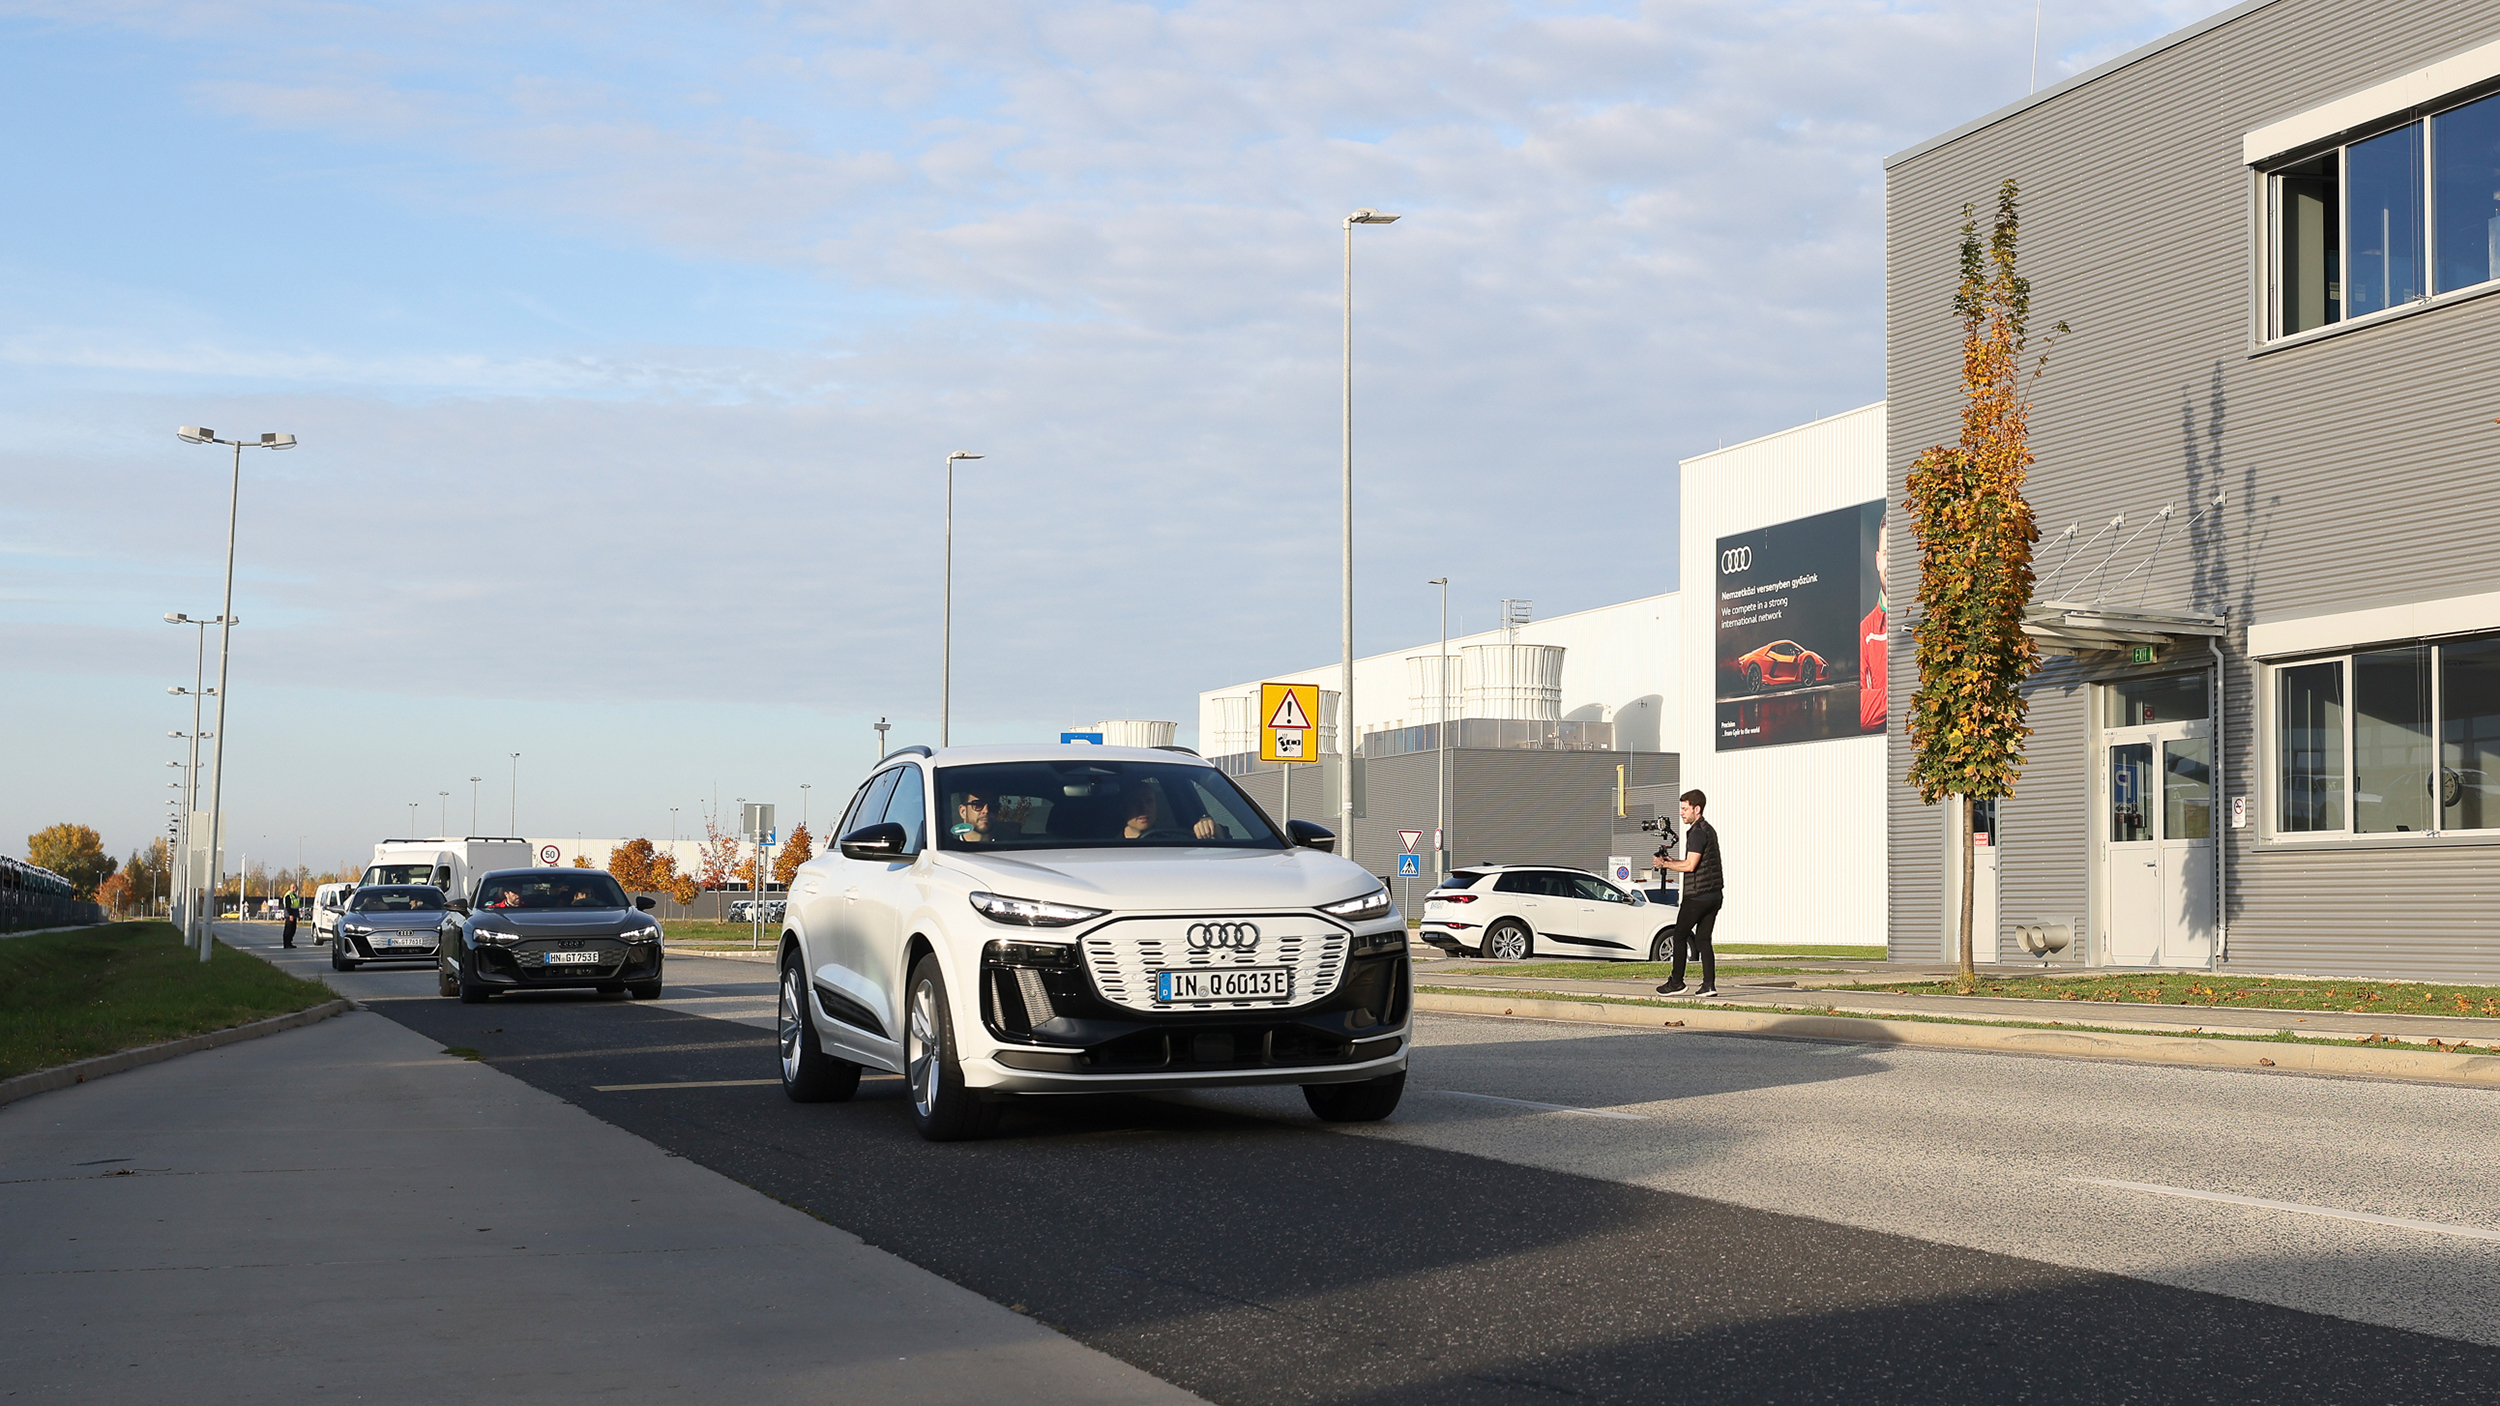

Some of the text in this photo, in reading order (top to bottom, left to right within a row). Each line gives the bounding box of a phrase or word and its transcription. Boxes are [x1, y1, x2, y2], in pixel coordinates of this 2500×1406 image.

[1721, 573, 1818, 601] Nemzetközi versenyben győzünk
[1721, 607, 1731, 616] We
[1731, 603, 1757, 614] compete
[1757, 601, 1763, 610] in
[1768, 597, 1788, 607] strong
[1721, 610, 1783, 629] international network
[2135, 648, 2148, 662] EXIT
[545, 850, 556, 859] 50
[550, 954, 561, 962] HN
[1174, 975, 1197, 997] IN
